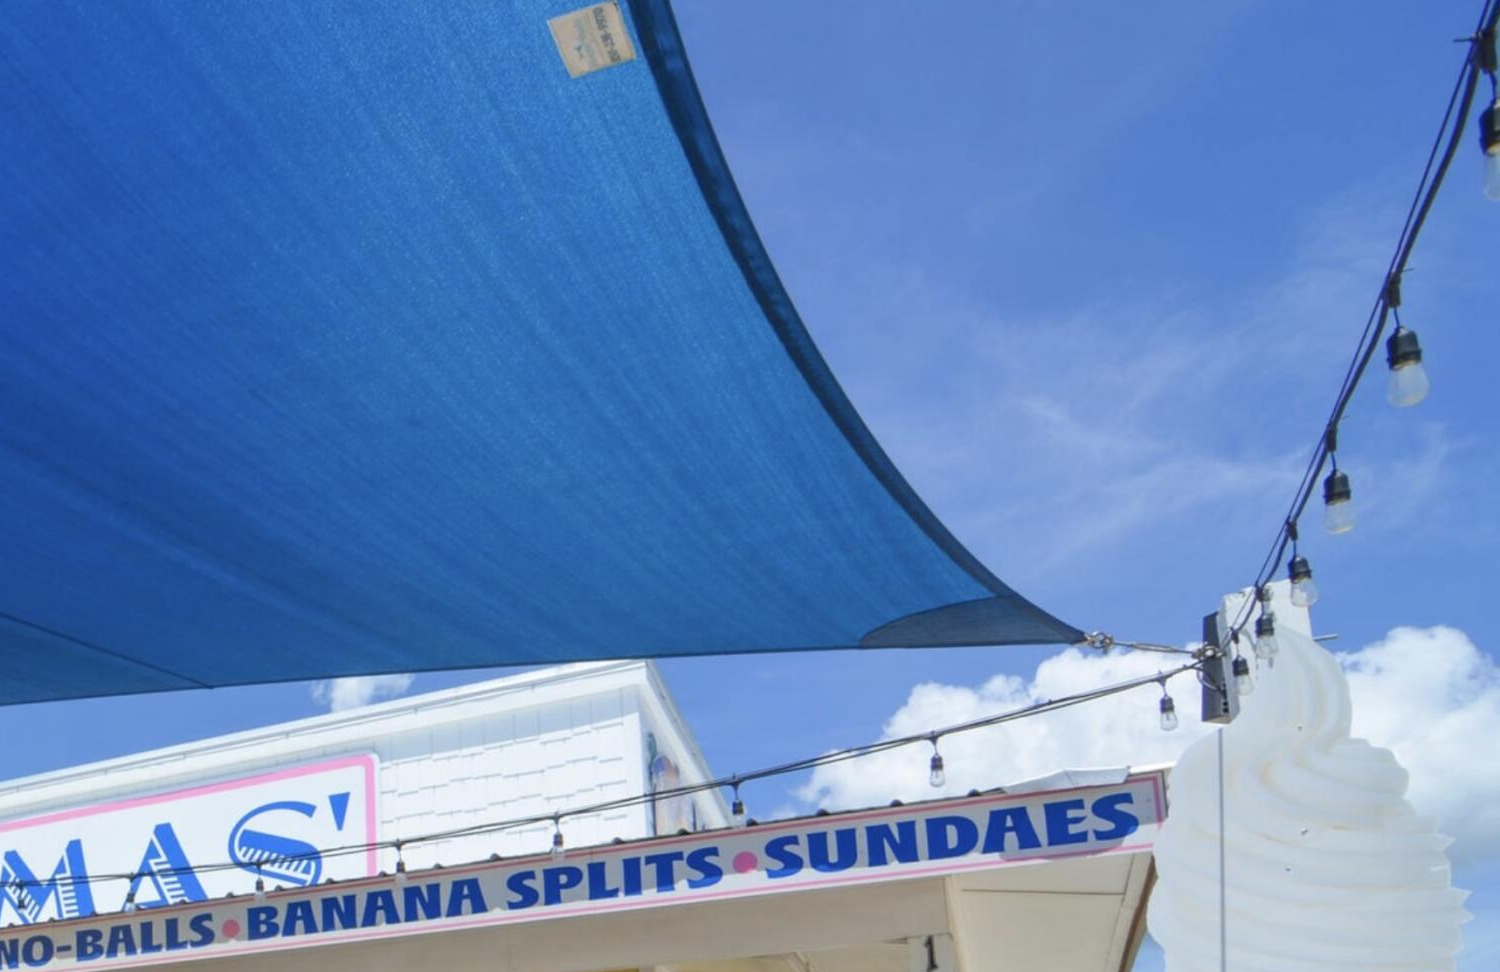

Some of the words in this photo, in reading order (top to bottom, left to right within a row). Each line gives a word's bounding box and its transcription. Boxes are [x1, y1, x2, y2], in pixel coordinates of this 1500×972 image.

[246, 877, 489, 941] BANANA
[506, 845, 723, 912] SPLITS
[764, 791, 1140, 880] SUNDAES
